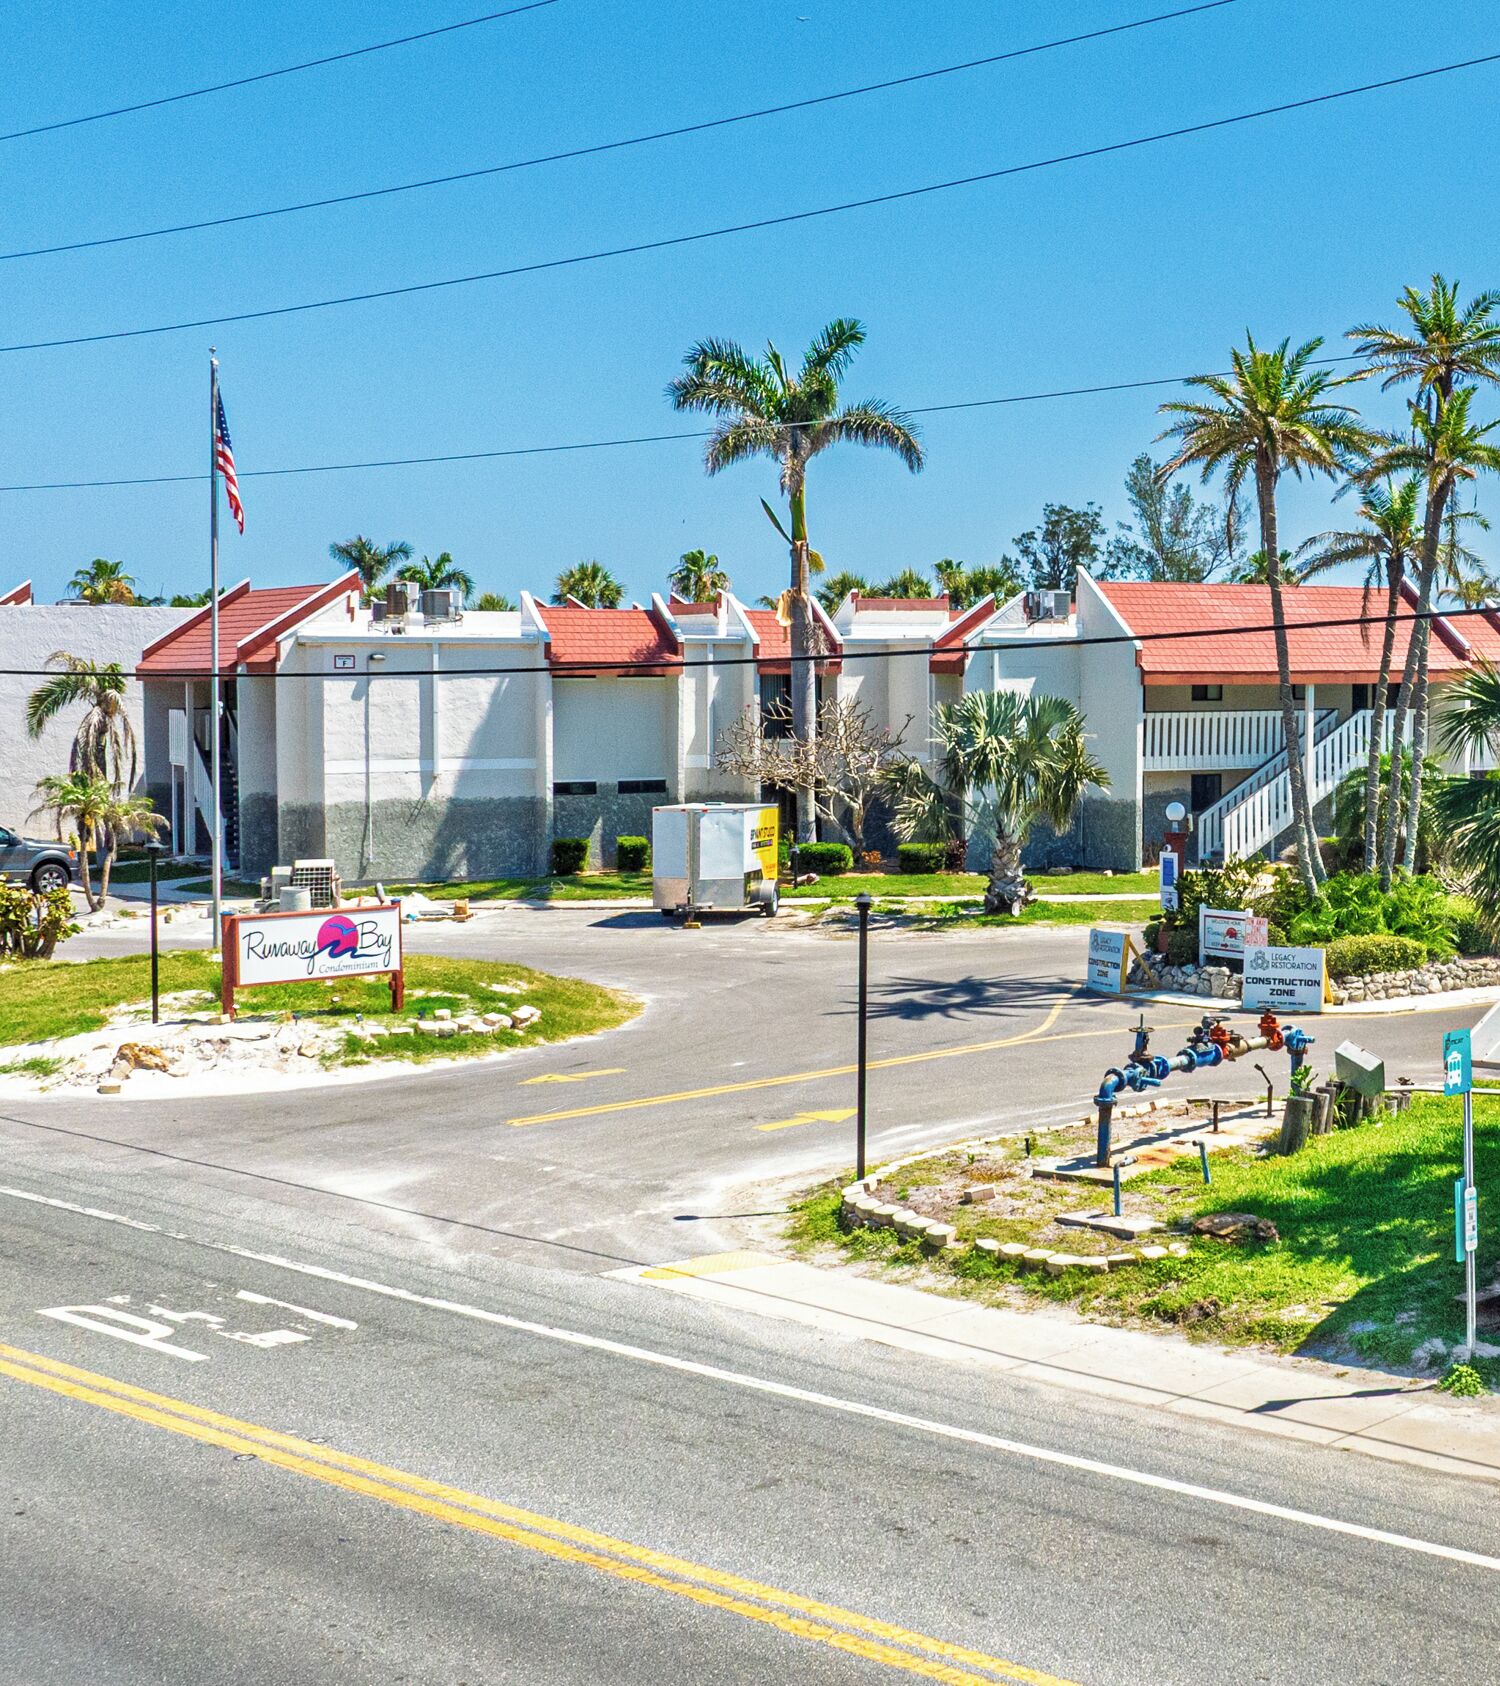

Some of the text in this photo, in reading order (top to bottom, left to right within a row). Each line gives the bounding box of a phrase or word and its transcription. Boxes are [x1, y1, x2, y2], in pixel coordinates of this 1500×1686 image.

[242, 920, 393, 975] Runaway Bay
[1271, 953, 1296, 962] LEGACY
[318, 960, 379, 974] Condominium
[1088, 958, 1120, 969] CONSTRUCTION
[1271, 961, 1317, 970] RESTORATION
[1097, 969, 1108, 978] ZONE
[1245, 976, 1321, 987] CONSTRUCTION
[1269, 988, 1296, 997] ZONE
